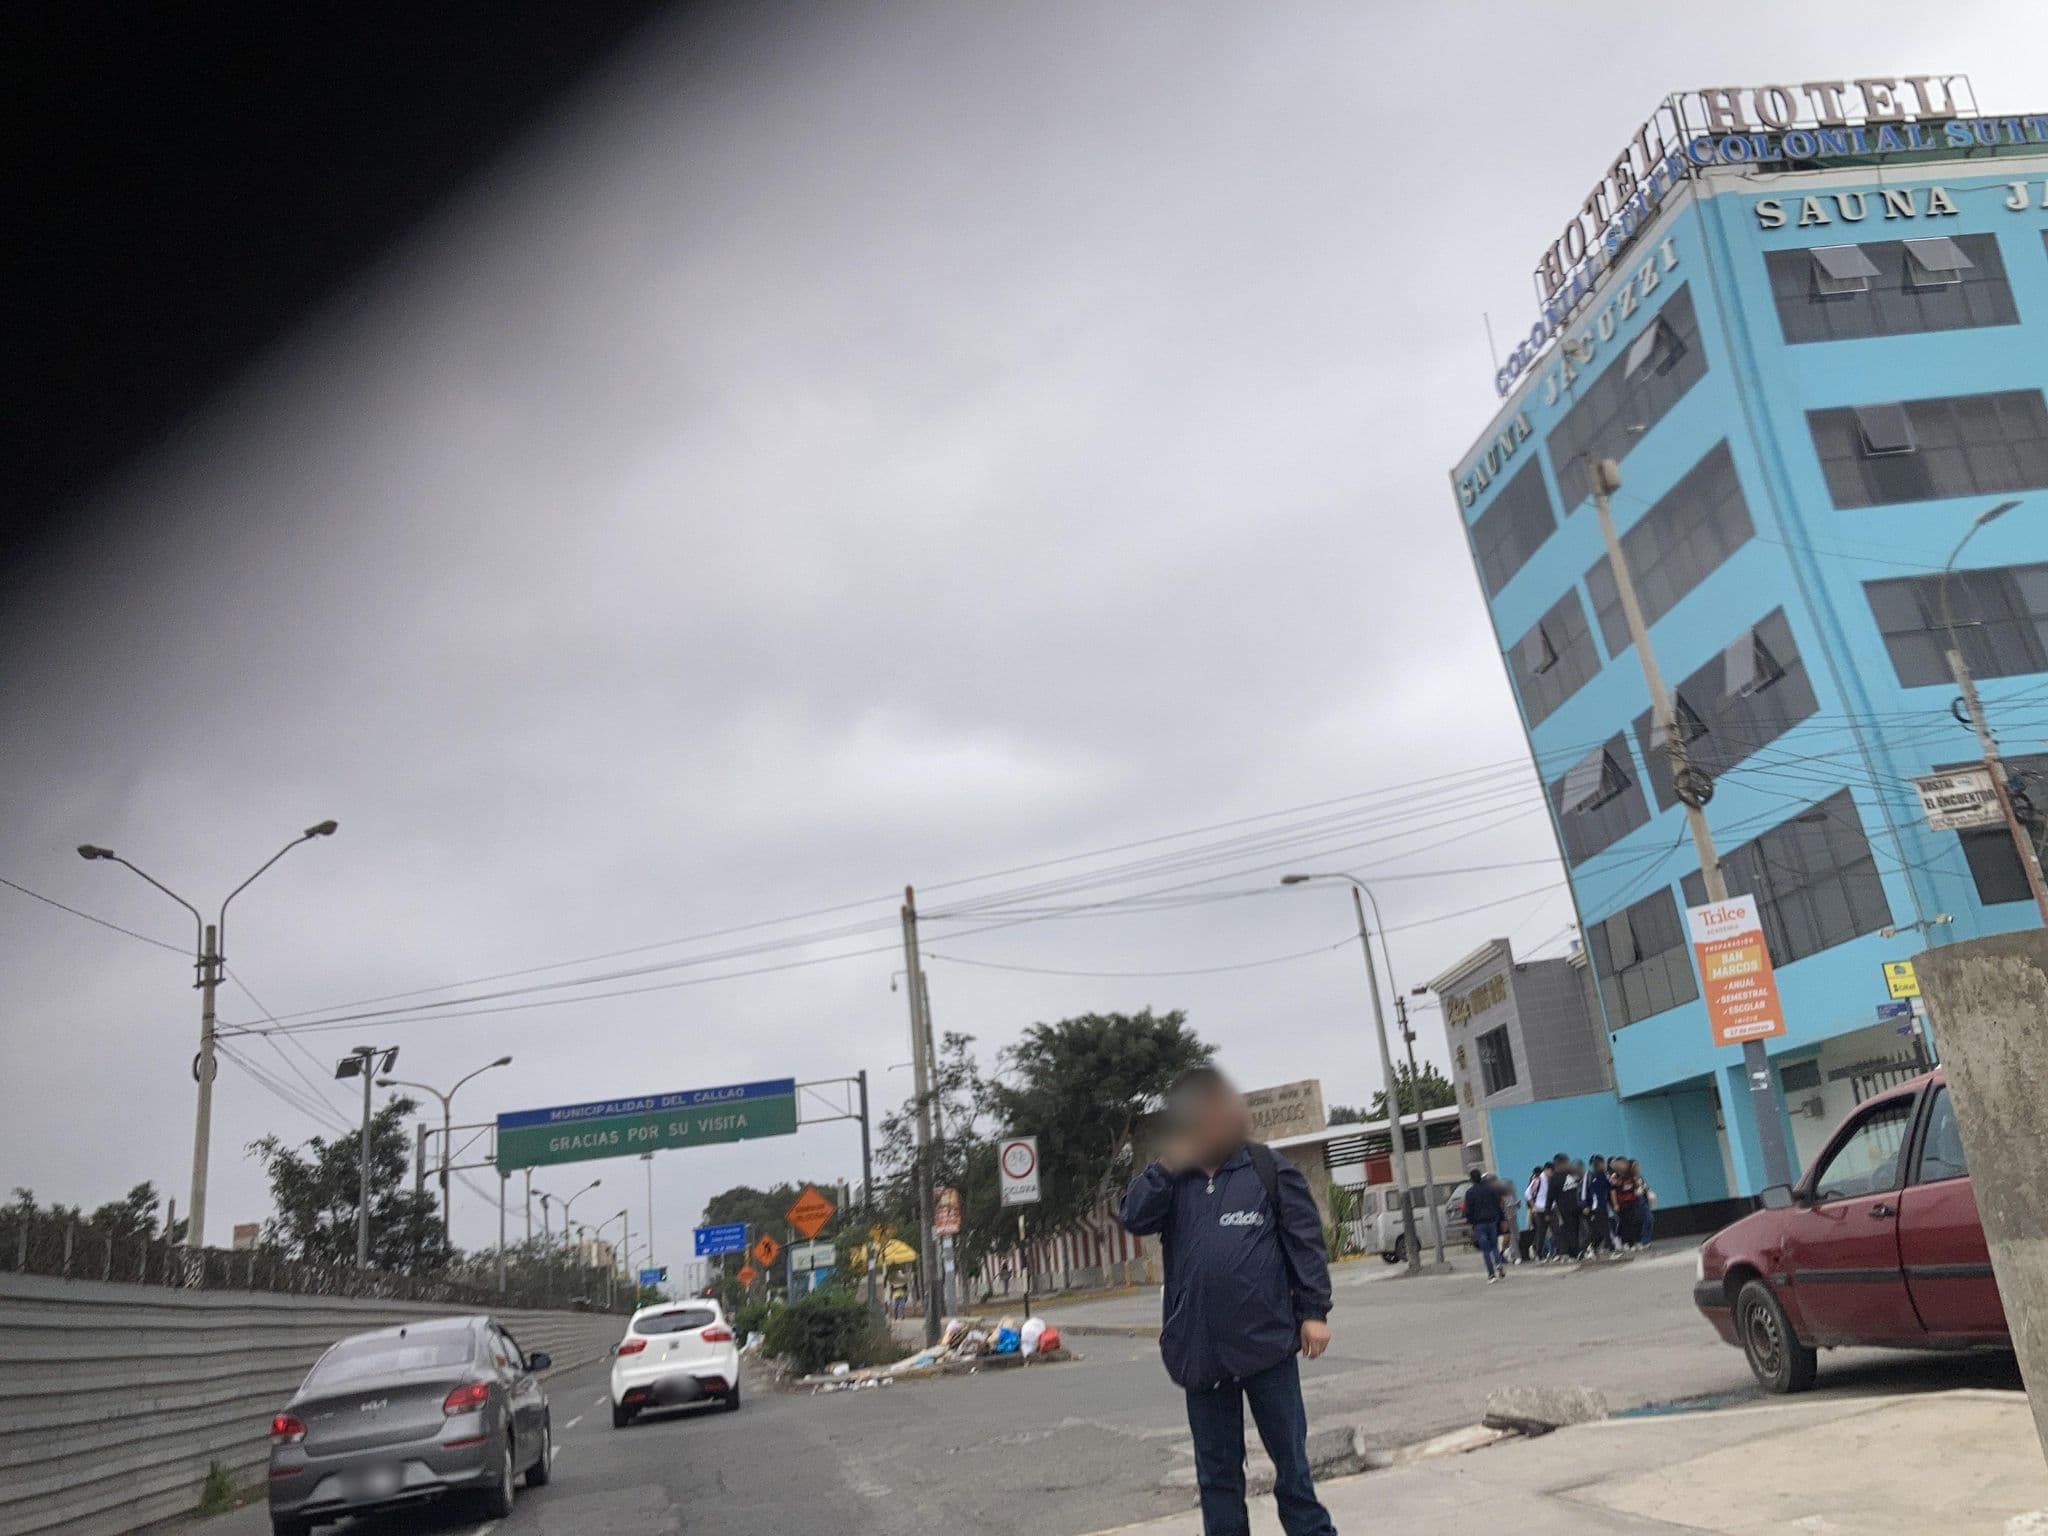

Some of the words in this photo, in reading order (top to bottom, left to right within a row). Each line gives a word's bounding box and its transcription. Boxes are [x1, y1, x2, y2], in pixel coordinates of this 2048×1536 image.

[1702, 75, 1957, 133] HOTEL
[1688, 123, 1936, 167] COLONIAL
[1536, 122, 1666, 298] HOTEL
[1755, 186, 1960, 229] SAUNA
[1459, 411, 1534, 508] SAUNA
[1544, 237, 1680, 407] JACUZZI
[1698, 905, 1746, 926] Trilce
[1711, 960, 1759, 979] MARCOS
[1722, 952, 1744, 965] SAN
[1719, 988, 1769, 1005] SEMESTRAL
[1728, 978, 1756, 991] ANUAL
[1728, 1000, 1766, 1015] ESCOLAR
[551, 1099, 655, 1121] MUNICIPALIDAD
[661, 1094, 686, 1108] DEL
[694, 1087, 746, 1104] CALLAO
[549, 1131, 620, 1153] GRACIAS
[628, 1126, 660, 1143] POR
[668, 1122, 690, 1138] SU
[698, 1114, 749, 1133] VISITA
